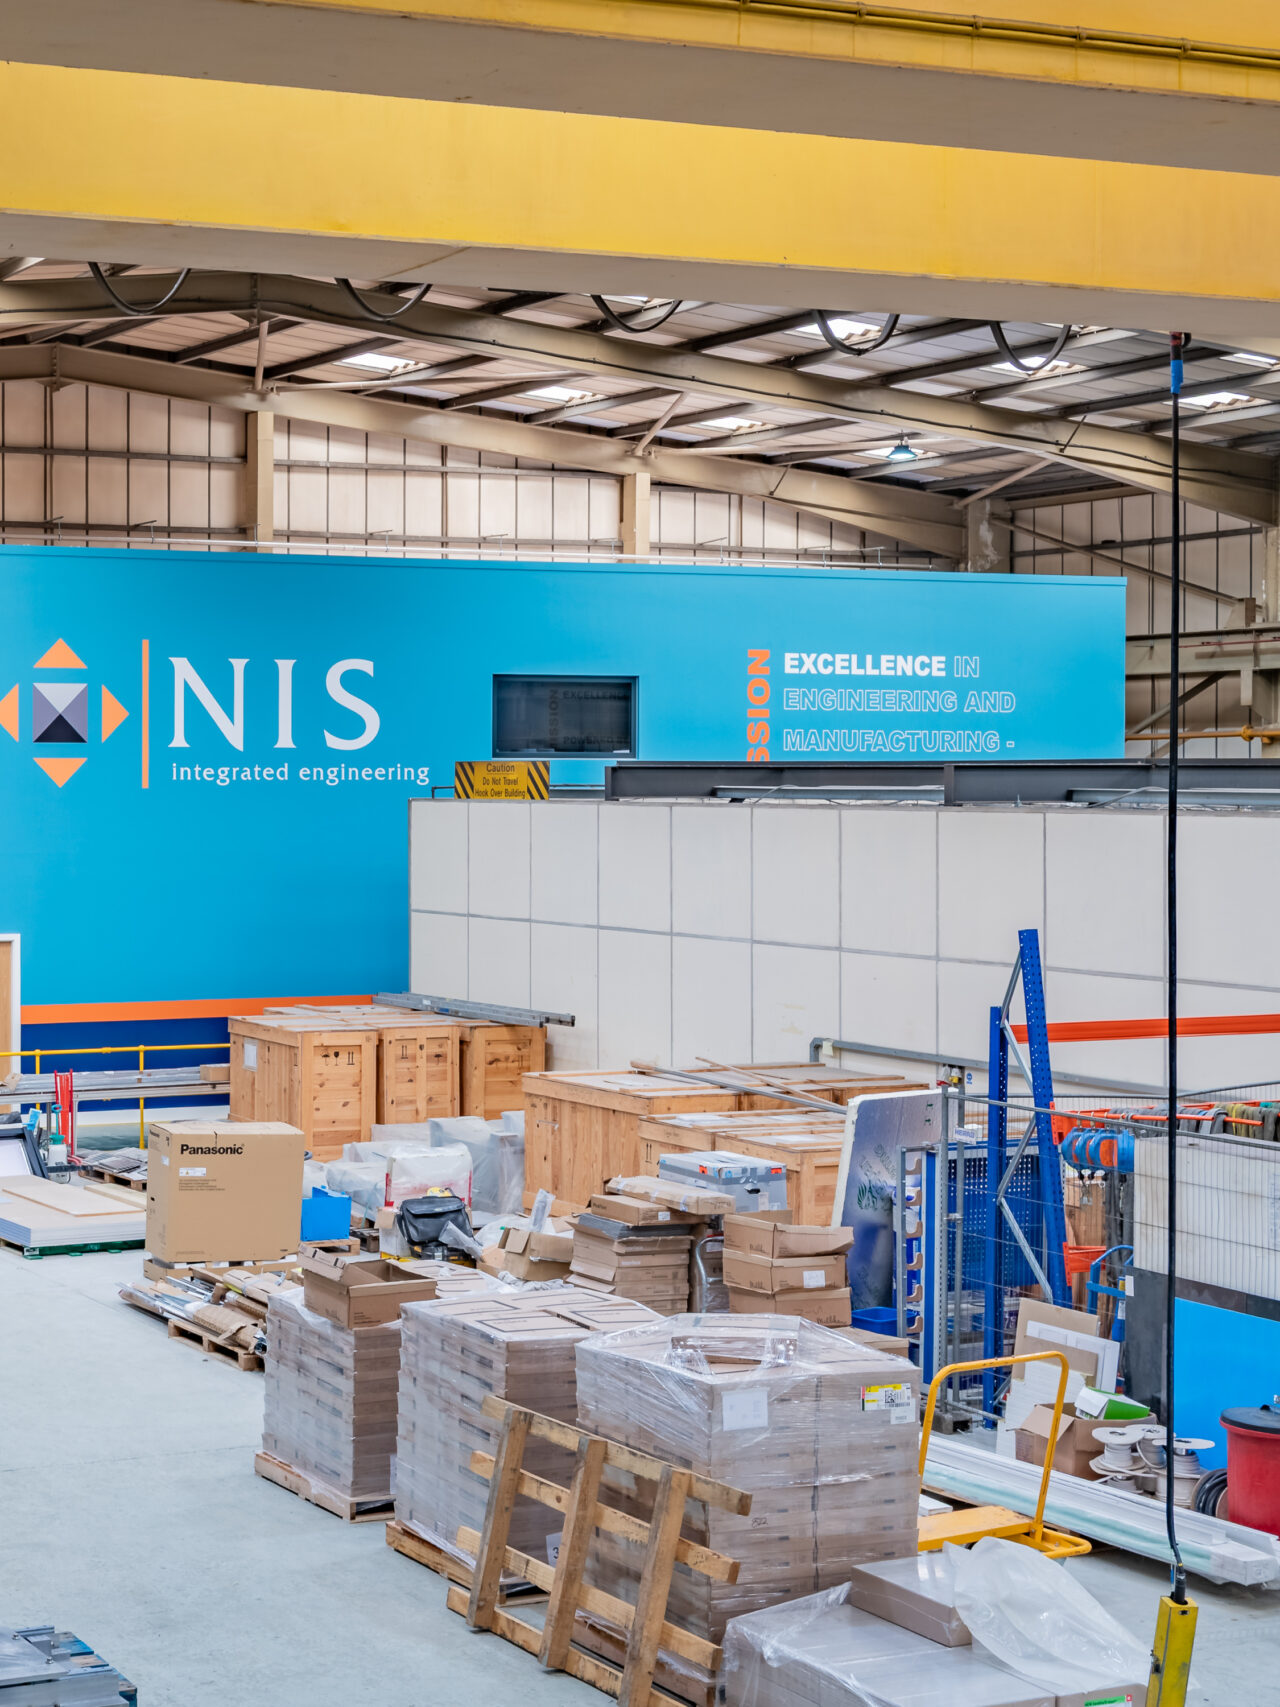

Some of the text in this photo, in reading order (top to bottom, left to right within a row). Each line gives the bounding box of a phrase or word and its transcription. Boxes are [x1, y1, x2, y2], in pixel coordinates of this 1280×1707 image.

[784, 652, 980, 677] EXCELLENCE IN
[167, 656, 381, 752] NIS
[783, 688, 1016, 713] ENGINEERING AND
[783, 729, 1000, 752] MANUFACTURING
[171, 762, 430, 786] integrated engineering
[486, 763, 515, 773] Caution
[482, 777, 519, 786] Do Not Travel
[475, 788, 525, 799] Hook Over Building
[180, 1143, 244, 1155] Panasonic
